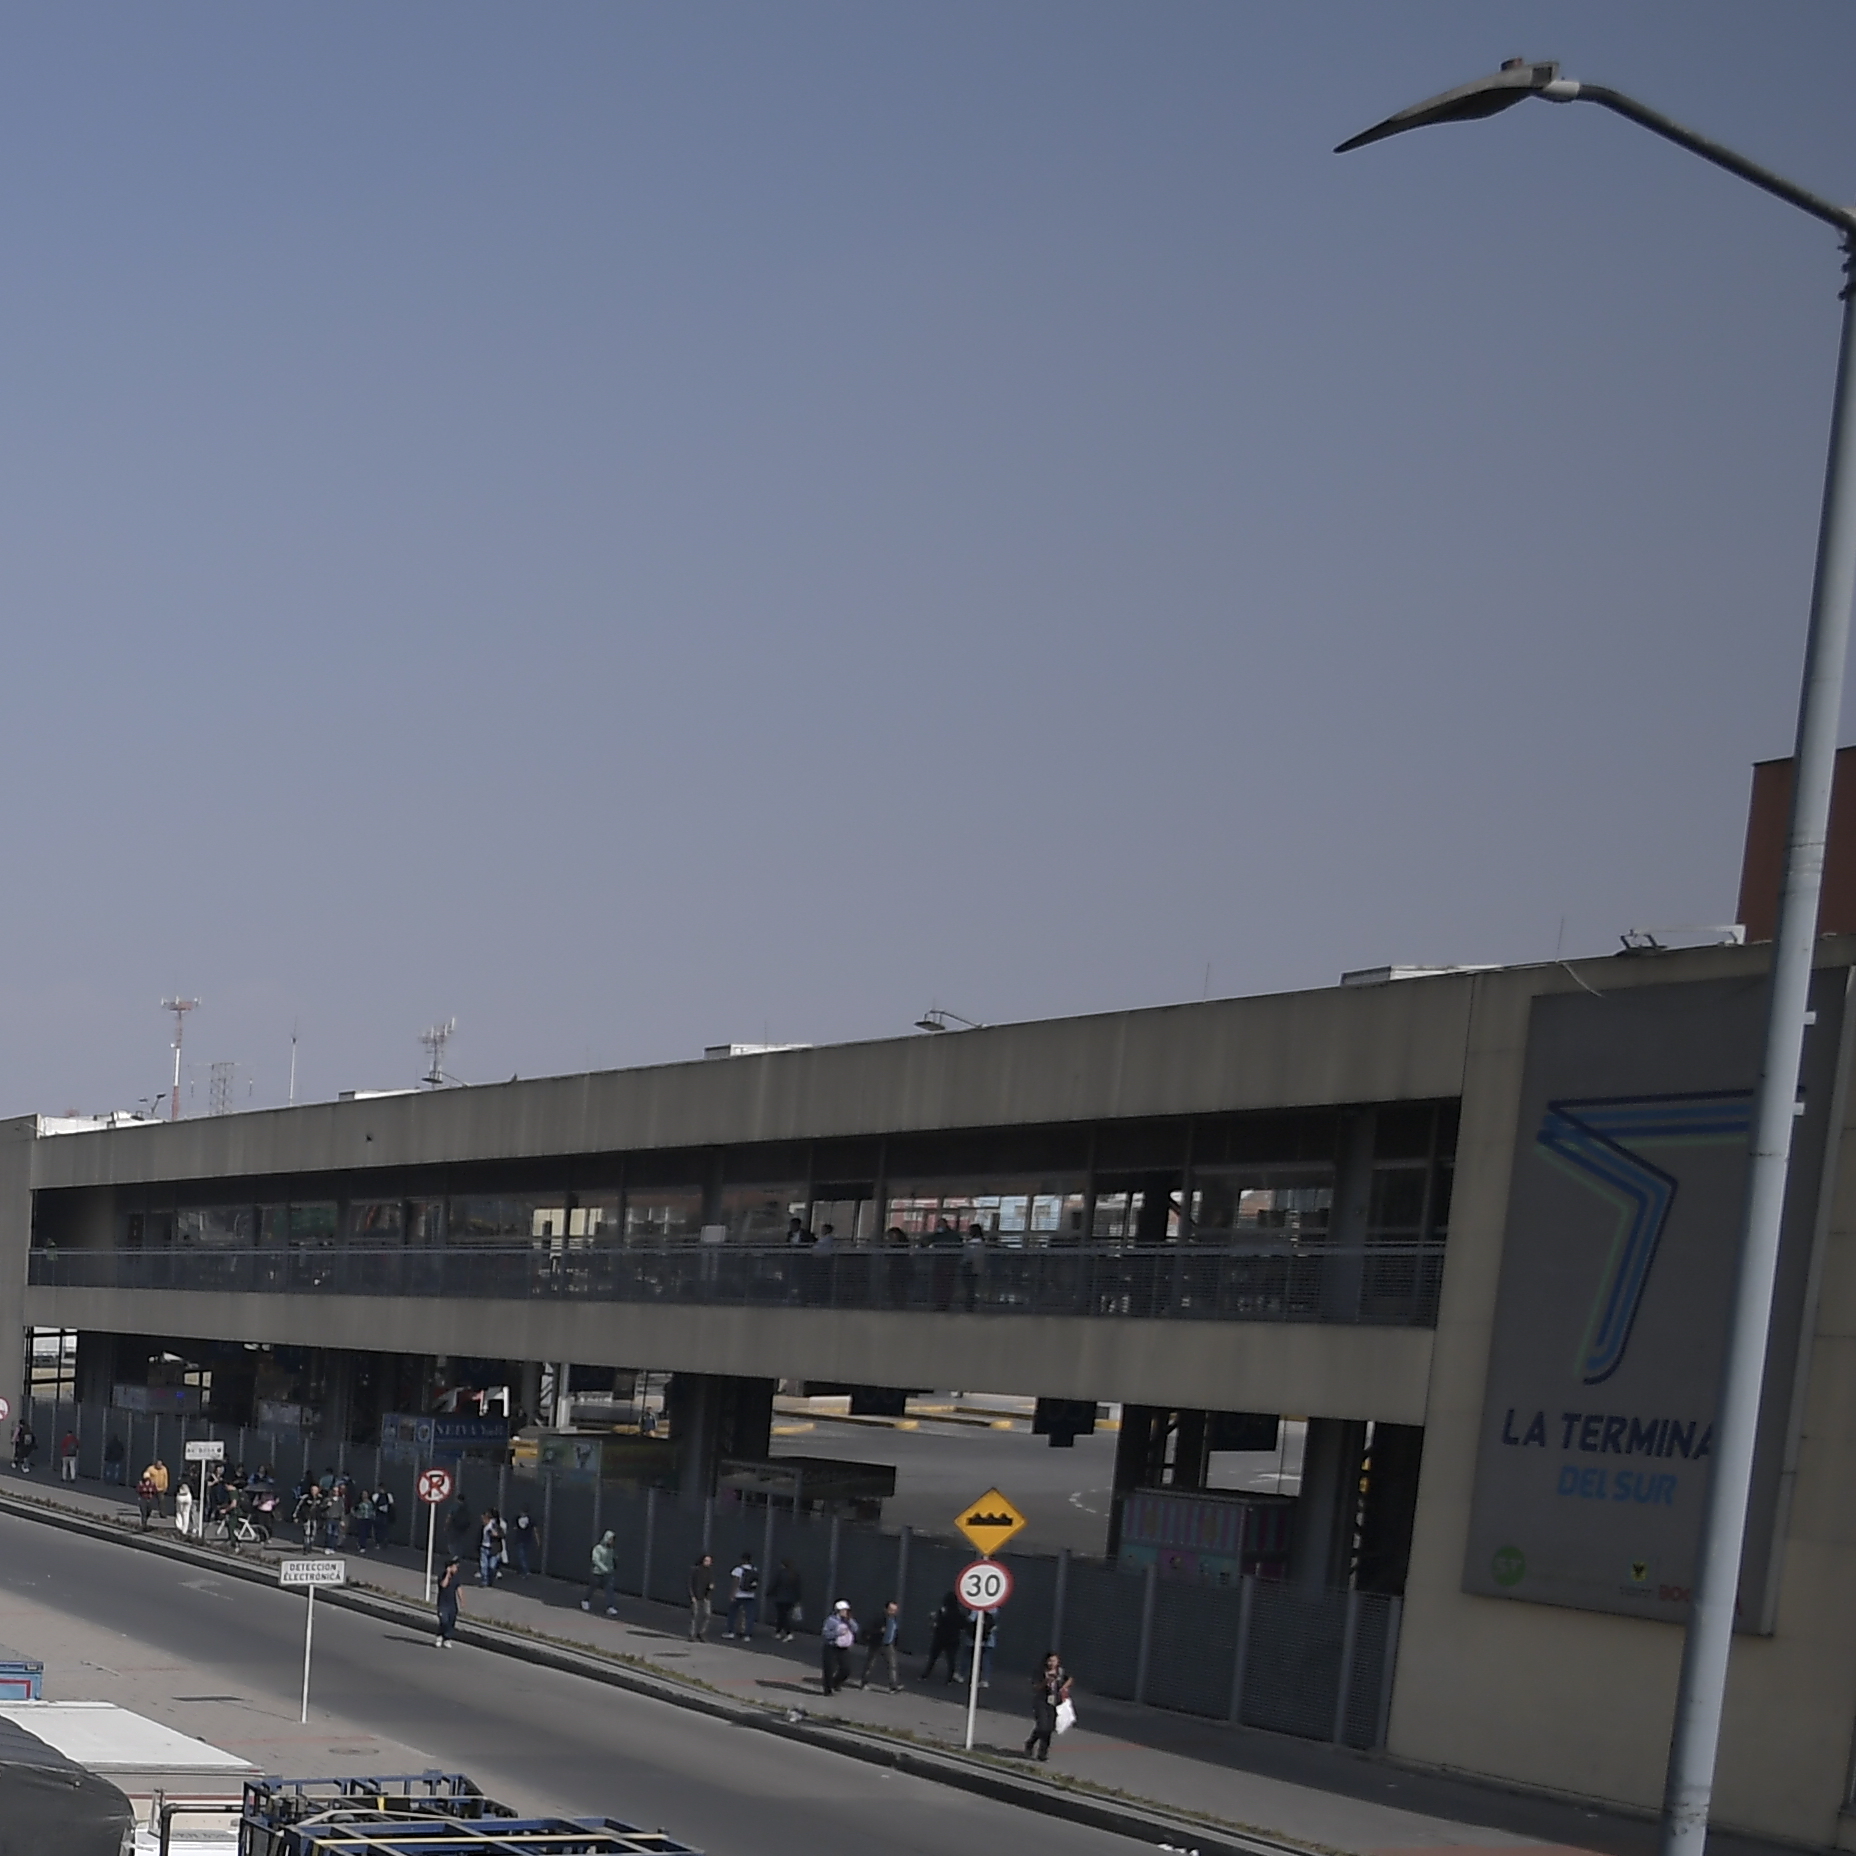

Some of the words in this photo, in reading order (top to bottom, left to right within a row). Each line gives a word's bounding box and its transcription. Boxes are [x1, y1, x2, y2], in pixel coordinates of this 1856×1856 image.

[1501, 1407, 1546, 1448] LA
[1556, 1464, 1608, 1499] DEL
[1612, 1470, 1678, 1506] SUR
[965, 1573, 1000, 1597] 30
